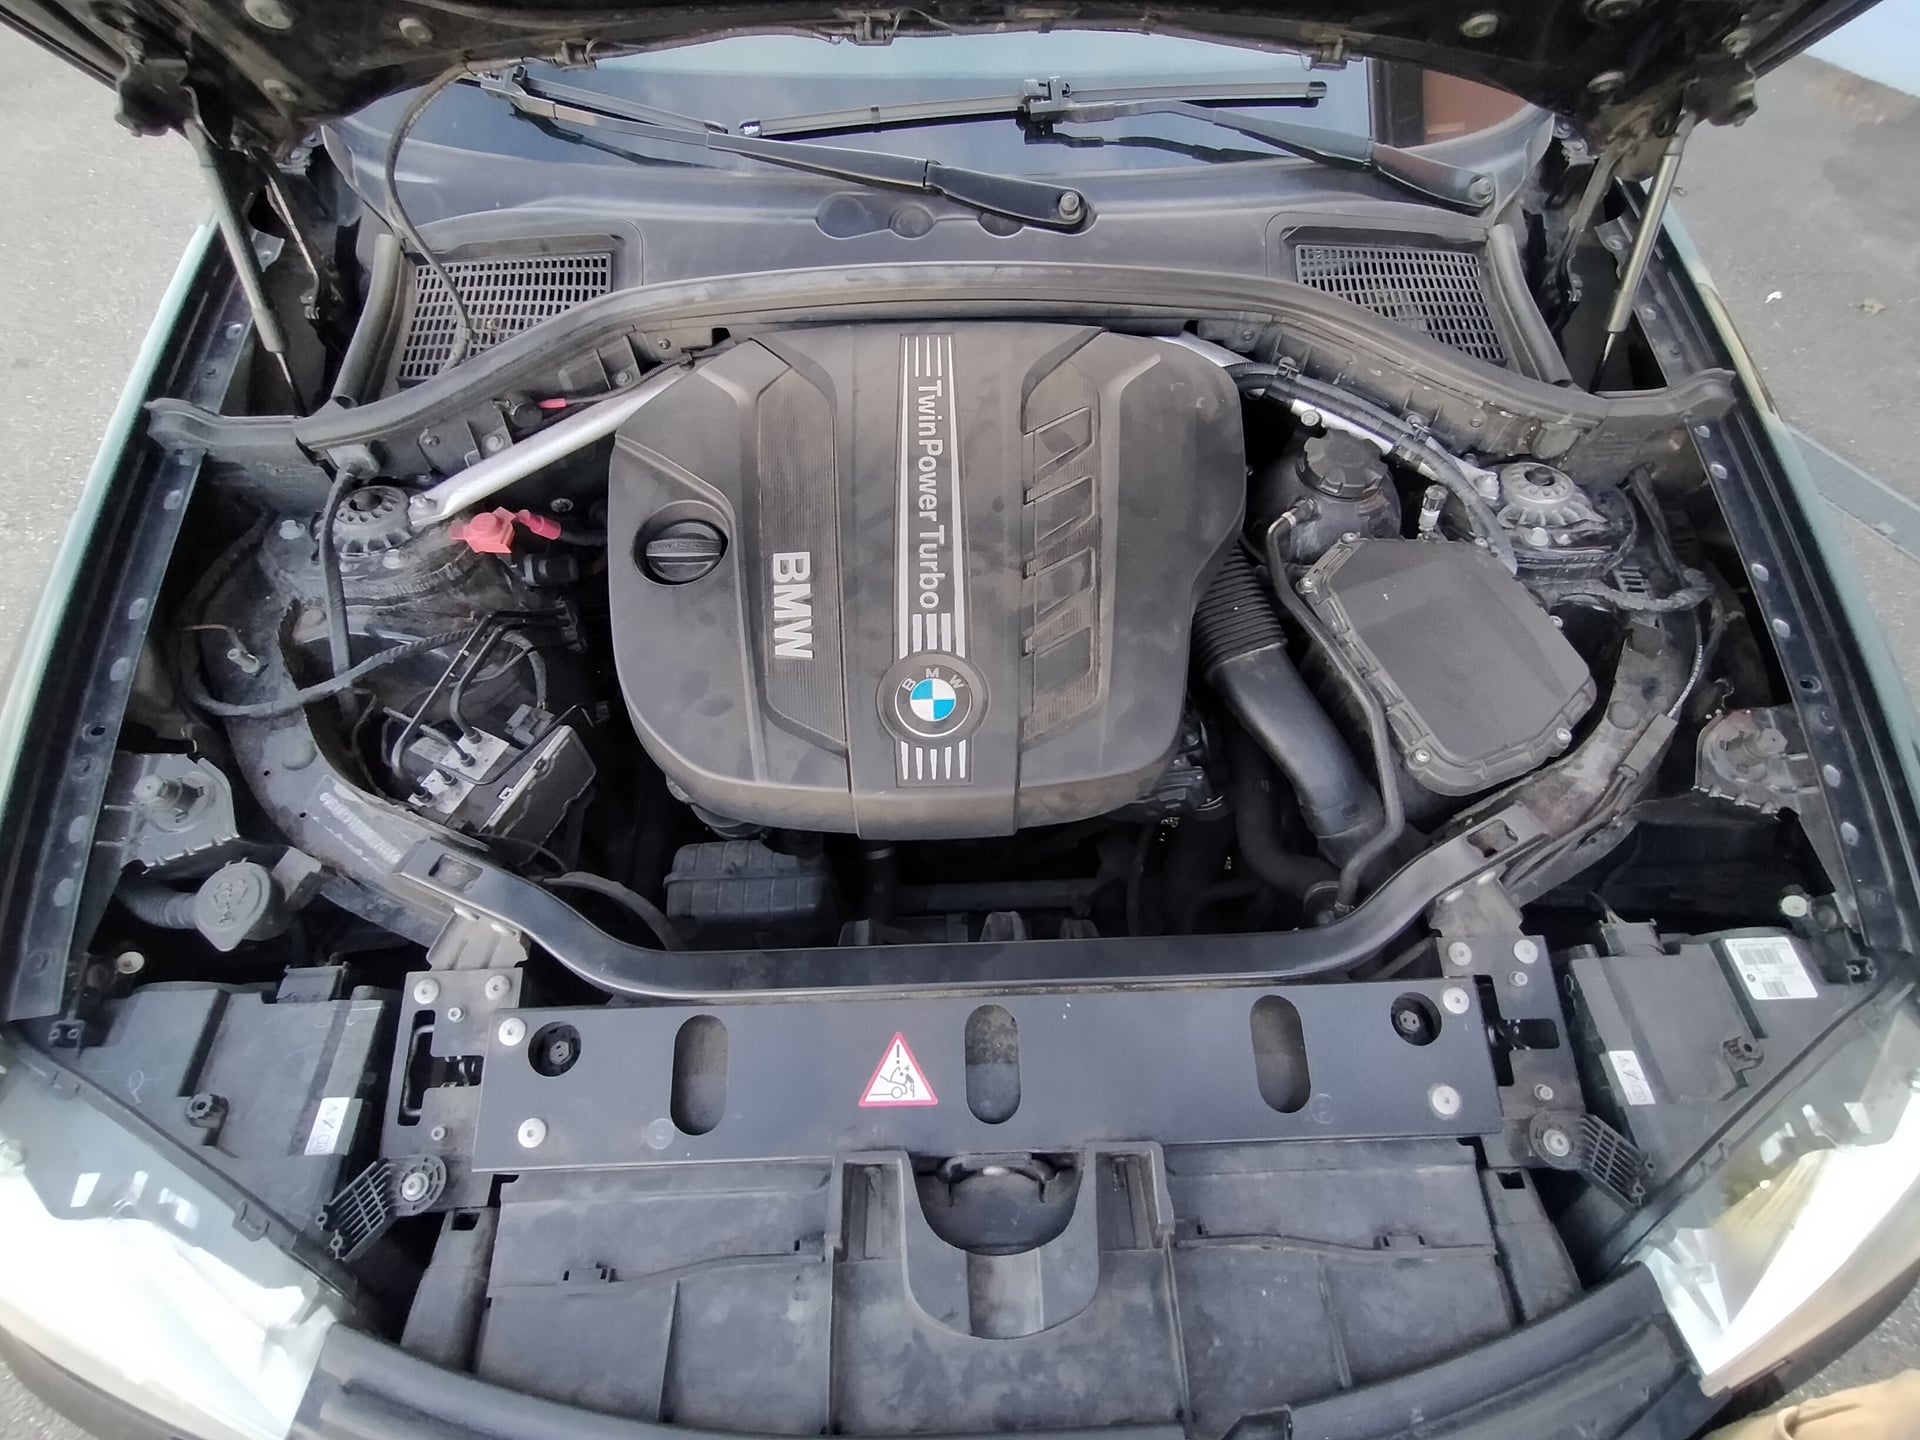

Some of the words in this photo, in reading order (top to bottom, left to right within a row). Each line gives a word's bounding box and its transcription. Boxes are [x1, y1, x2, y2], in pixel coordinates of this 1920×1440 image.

[918, 380, 943, 521] TwinPower
[773, 551, 813, 658] BMW
[919, 525, 946, 609] Turbo
[901, 667, 965, 692] BMW
